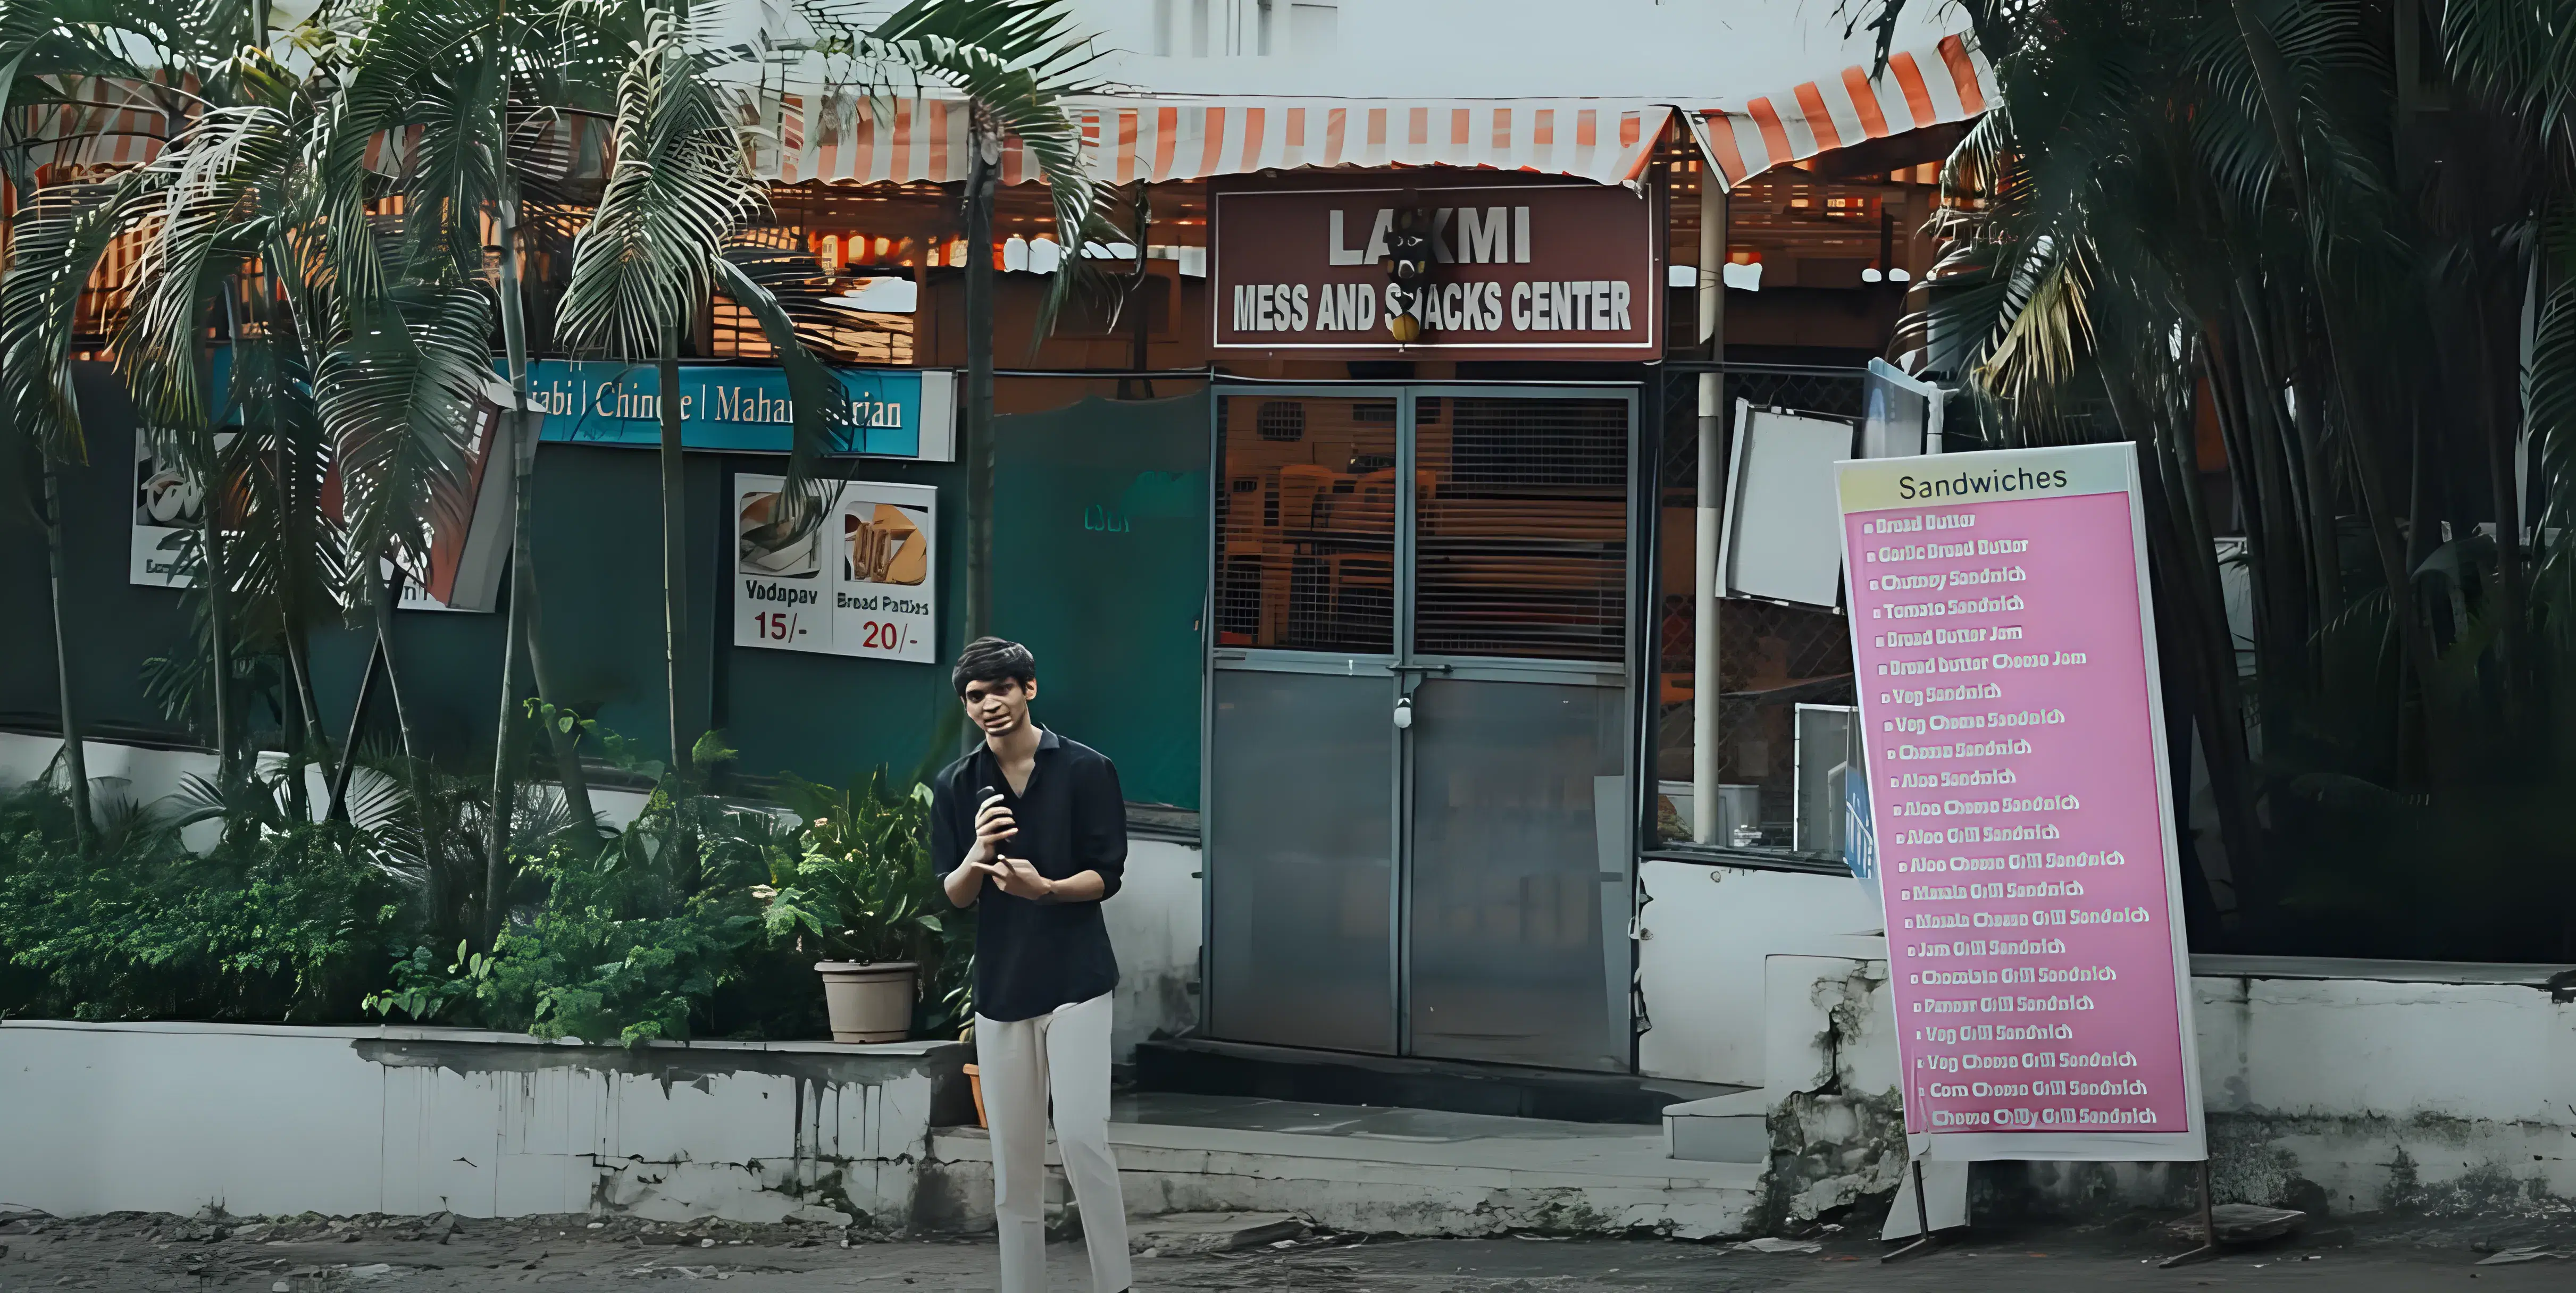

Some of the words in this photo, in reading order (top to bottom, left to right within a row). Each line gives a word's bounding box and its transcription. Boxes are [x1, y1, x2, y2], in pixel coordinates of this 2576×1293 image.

[1234, 284, 1309, 332] MESS
[1316, 283, 1375, 331] AND
[1511, 281, 1632, 331] CENTER
[596, 381, 692, 420] Chine
[1900, 467, 2068, 499] Sandwiches
[755, 611, 807, 643] 15/-
[863, 620, 918, 653] 20/-
